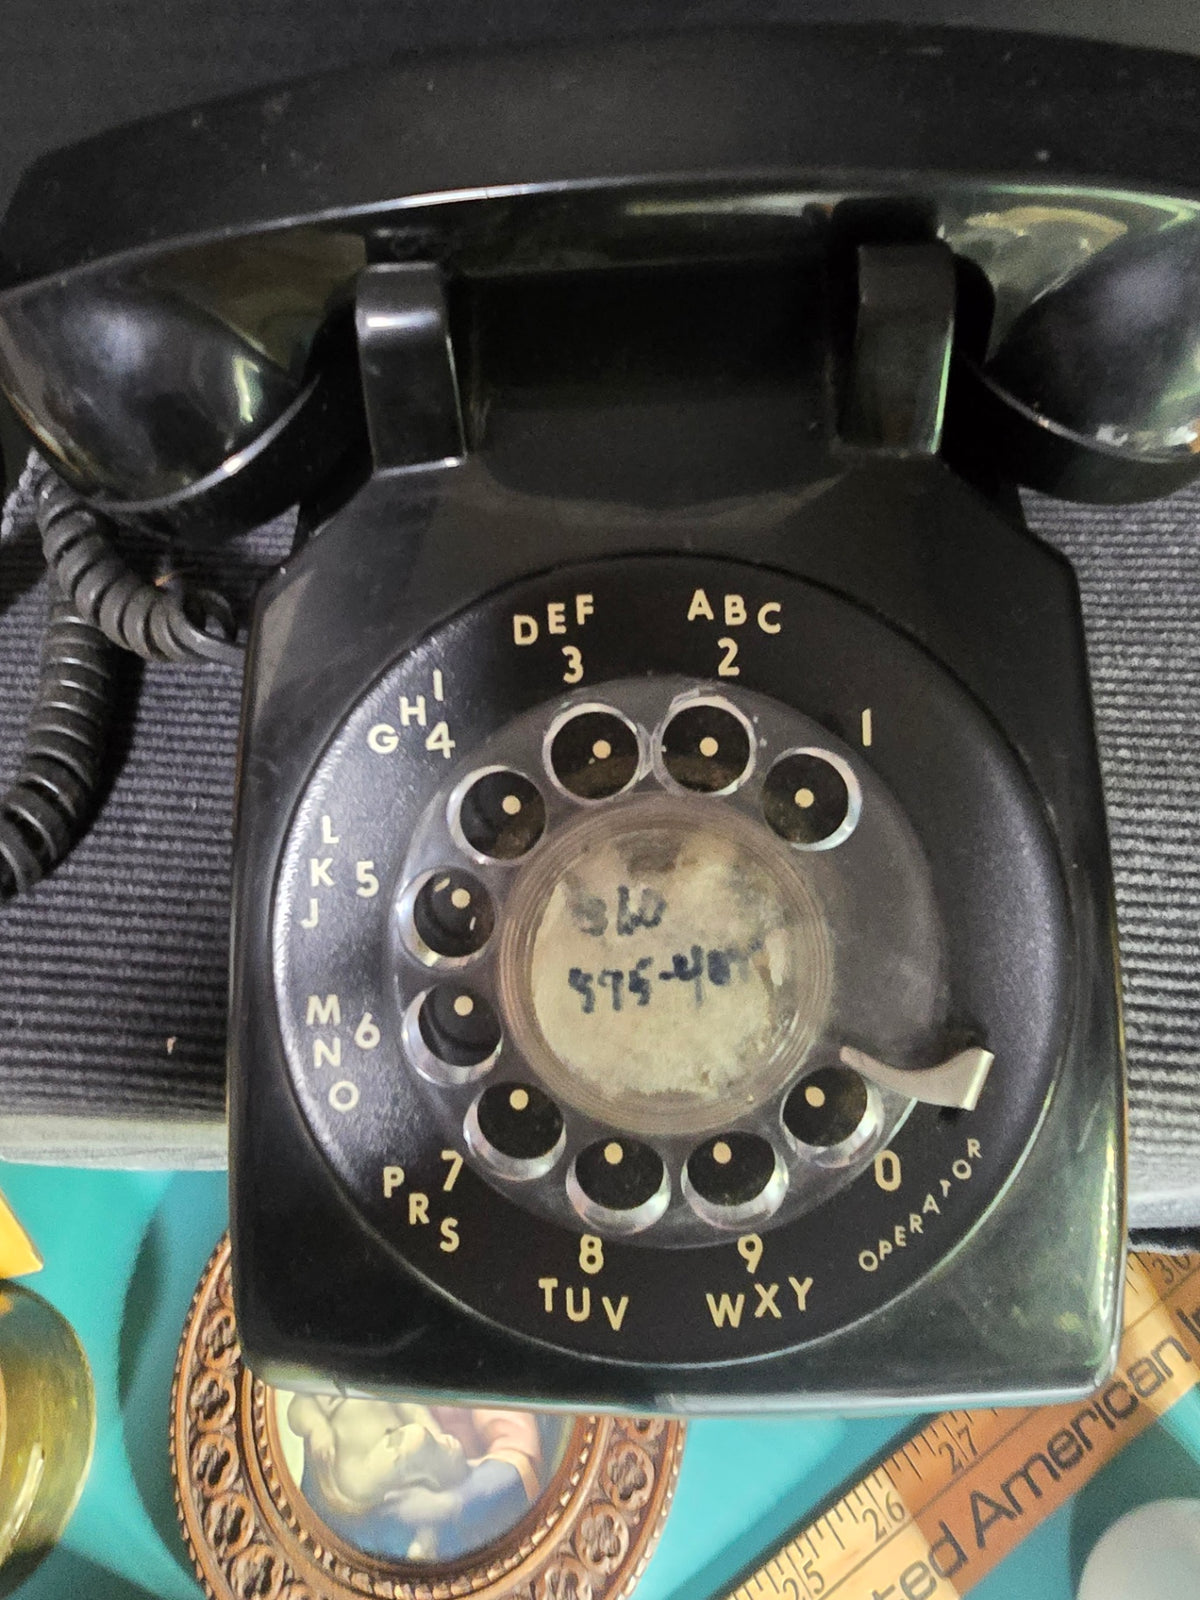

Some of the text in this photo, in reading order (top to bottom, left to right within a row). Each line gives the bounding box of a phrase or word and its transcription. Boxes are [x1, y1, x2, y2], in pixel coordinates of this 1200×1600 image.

[513, 594, 594, 645] DEF
[687, 589, 781, 634] ABC
[562, 646, 584, 684] 3
[717, 637, 740, 677] 2
[425, 721, 455, 758] 4
[356, 860, 379, 897] 5
[354, 1012, 380, 1050] 6
[441, 1151, 463, 1191] 7
[858, 1138, 982, 1272] OPERATOR
[579, 1234, 604, 1274] 8
[737, 1233, 763, 1273] 9
[538, 1278, 628, 1331] TUV
[705, 1277, 813, 1328] WXY
[938, 1424, 979, 1474] 27
[969, 1336, 1192, 1548] American
[861, 1491, 906, 1543] 26
[783, 1559, 825, 1600] 25
